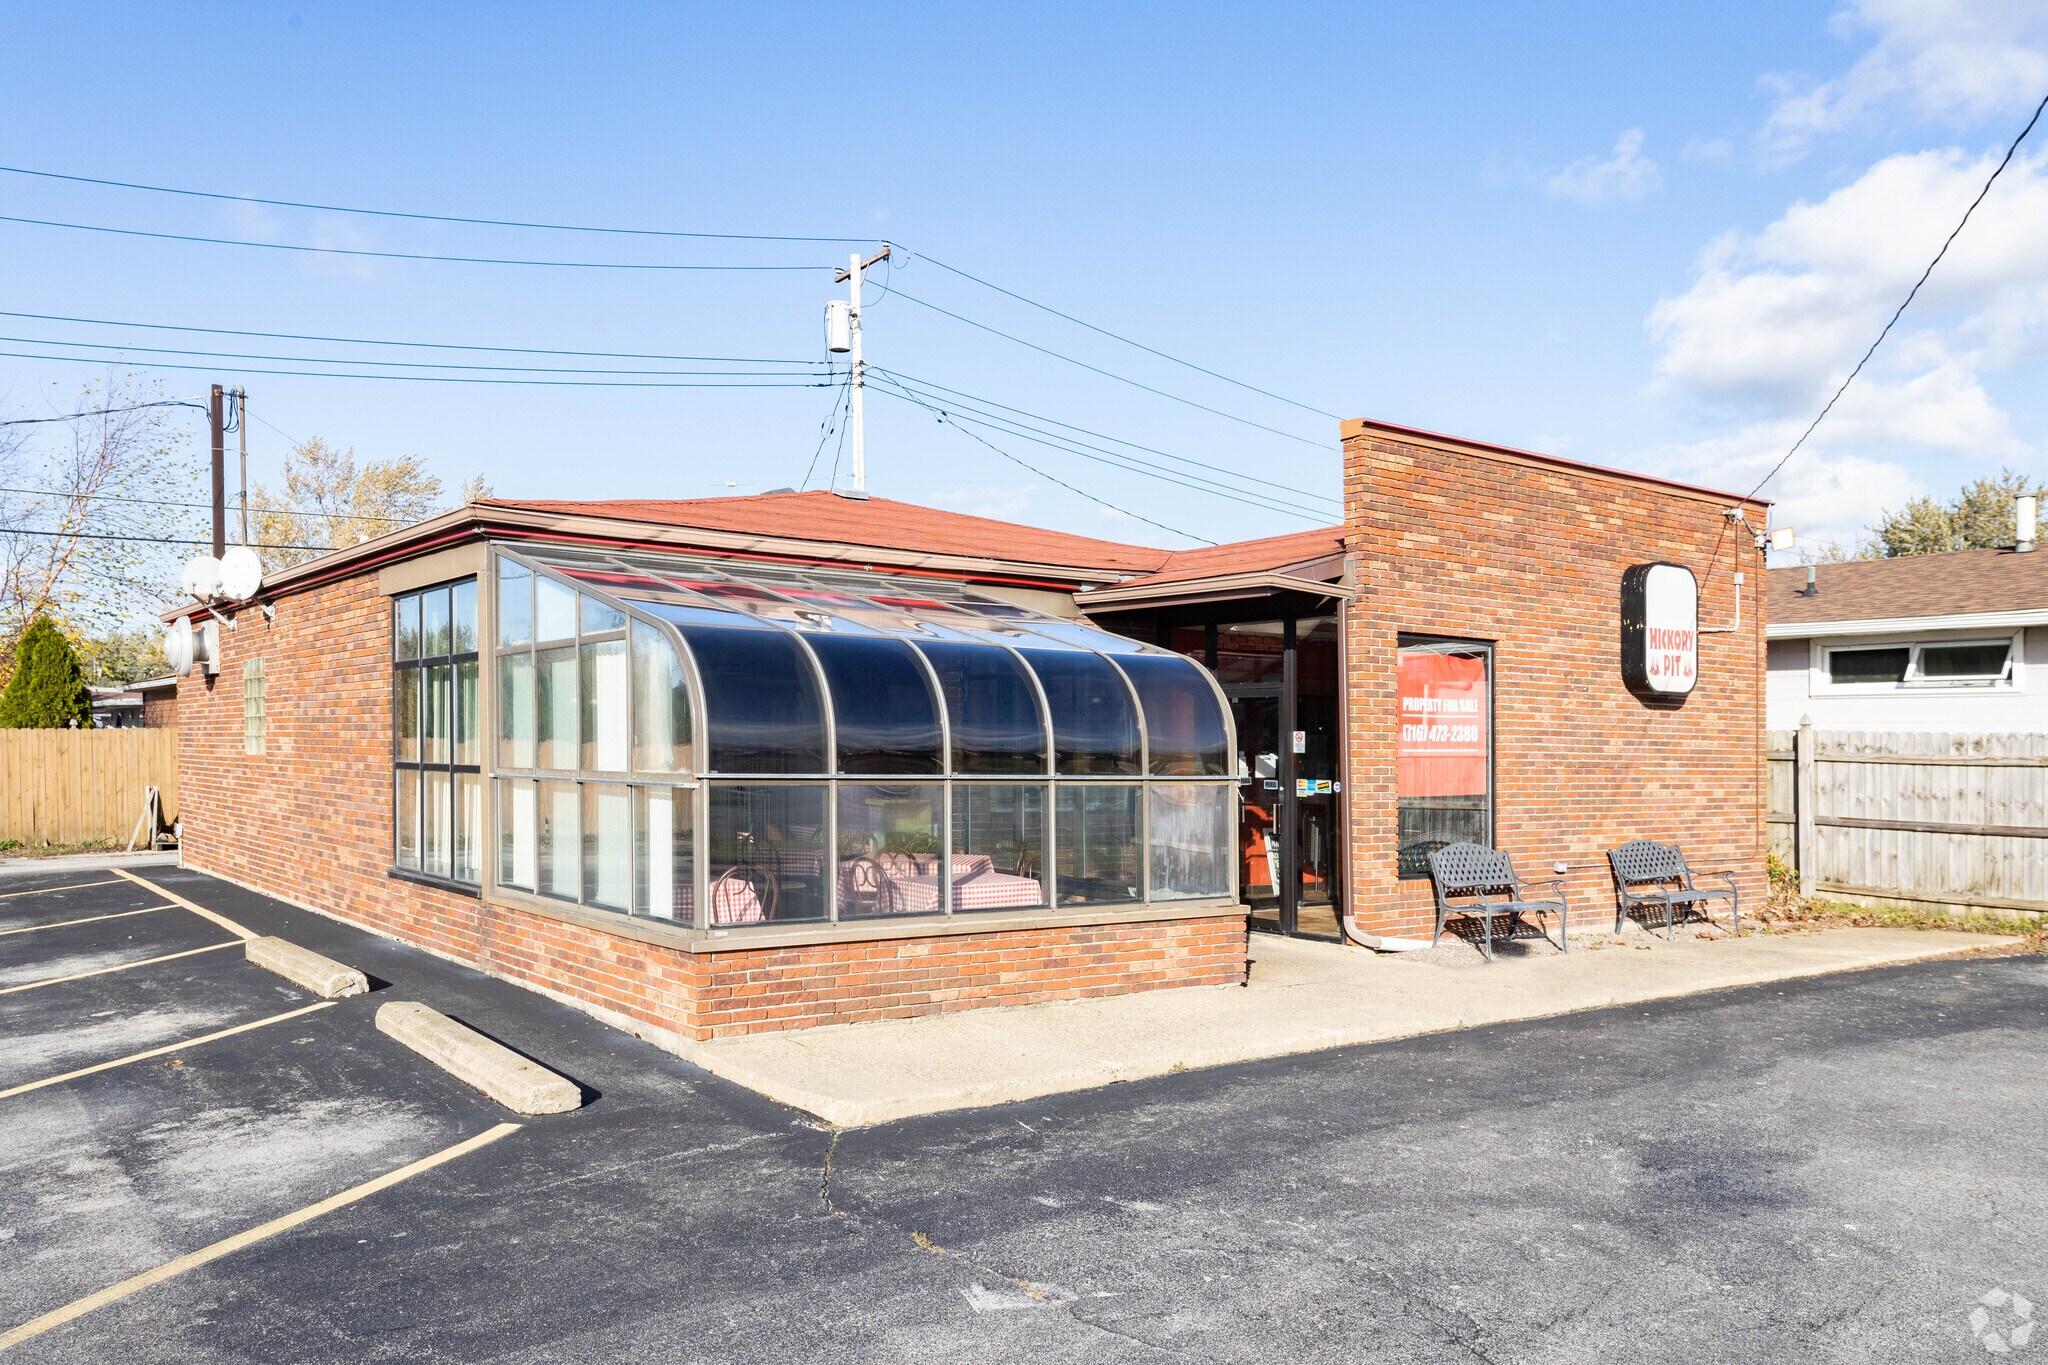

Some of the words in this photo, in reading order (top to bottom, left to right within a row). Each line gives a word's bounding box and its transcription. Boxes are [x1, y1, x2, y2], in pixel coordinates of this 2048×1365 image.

[1649, 628, 1694, 651] HICKORY
[1663, 655, 1681, 676] PIT
[1402, 697, 1442, 712] PROPERTY
[1443, 698, 1459, 713] FOR
[1459, 699, 1478, 713] SALE
[1429, 725, 1478, 742] 473-2380
